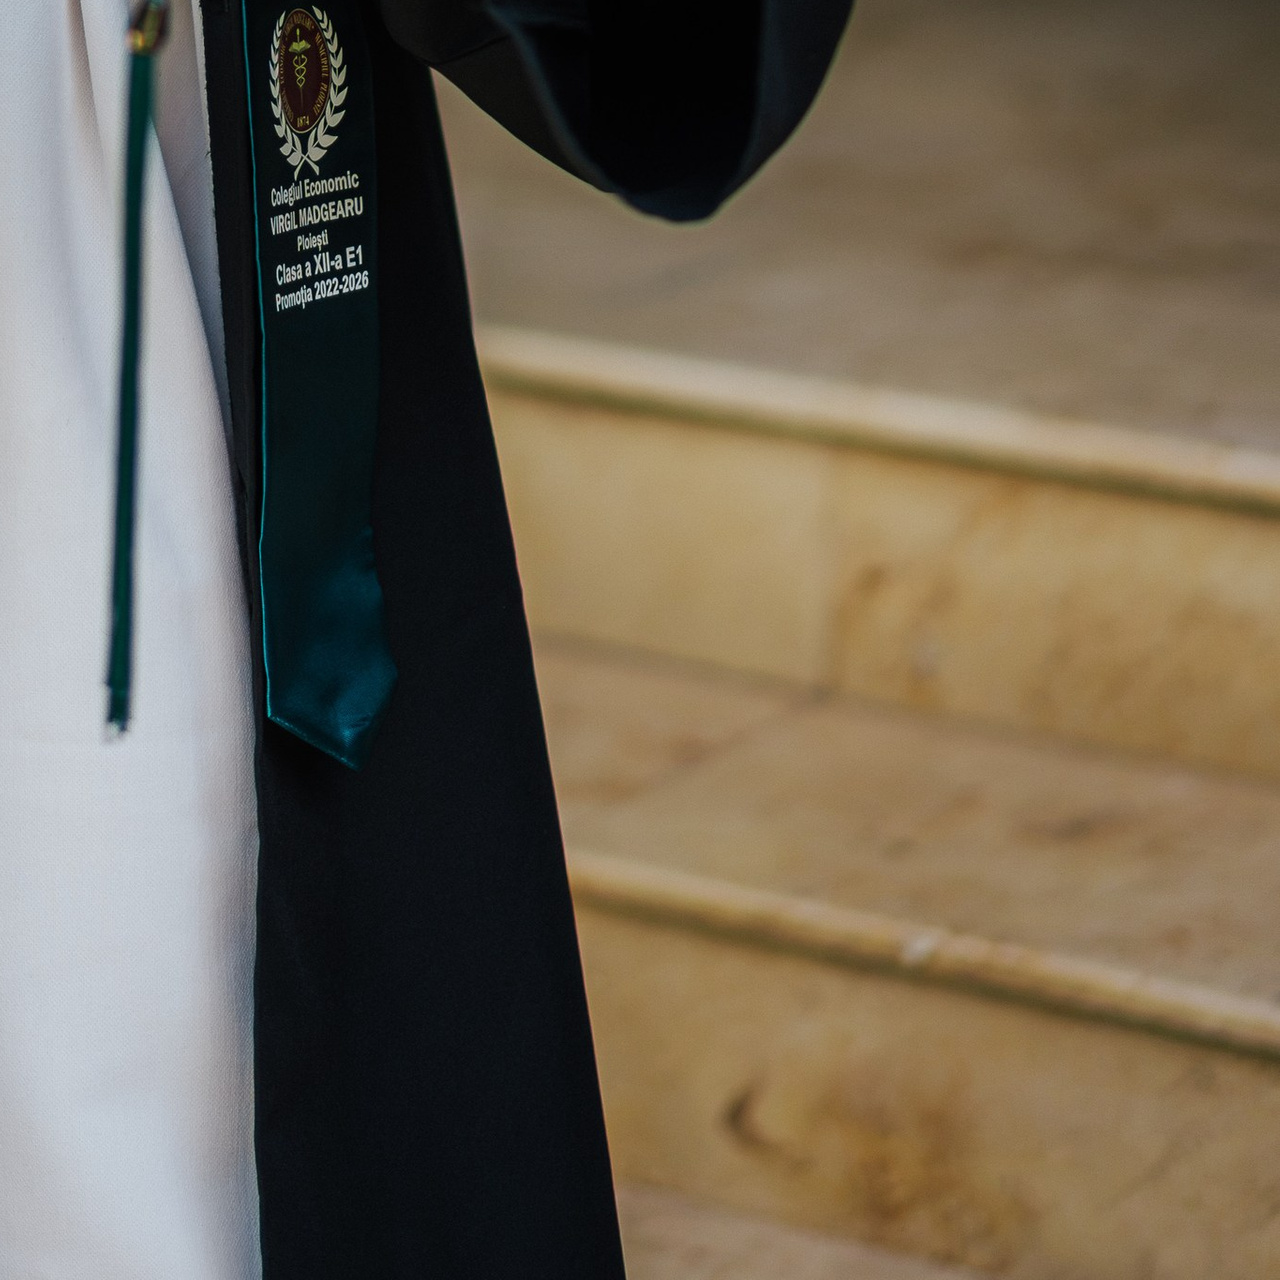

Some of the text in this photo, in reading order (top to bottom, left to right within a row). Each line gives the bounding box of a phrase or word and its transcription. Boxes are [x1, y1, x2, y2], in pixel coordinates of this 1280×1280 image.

[270, 170, 360, 207] Colegiul Economic
[270, 196, 364, 236] VIRGIL MADGEARU
[276, 245, 363, 286] Clasa a XII-a E1
[314, 270, 369, 300] 2022-2026
